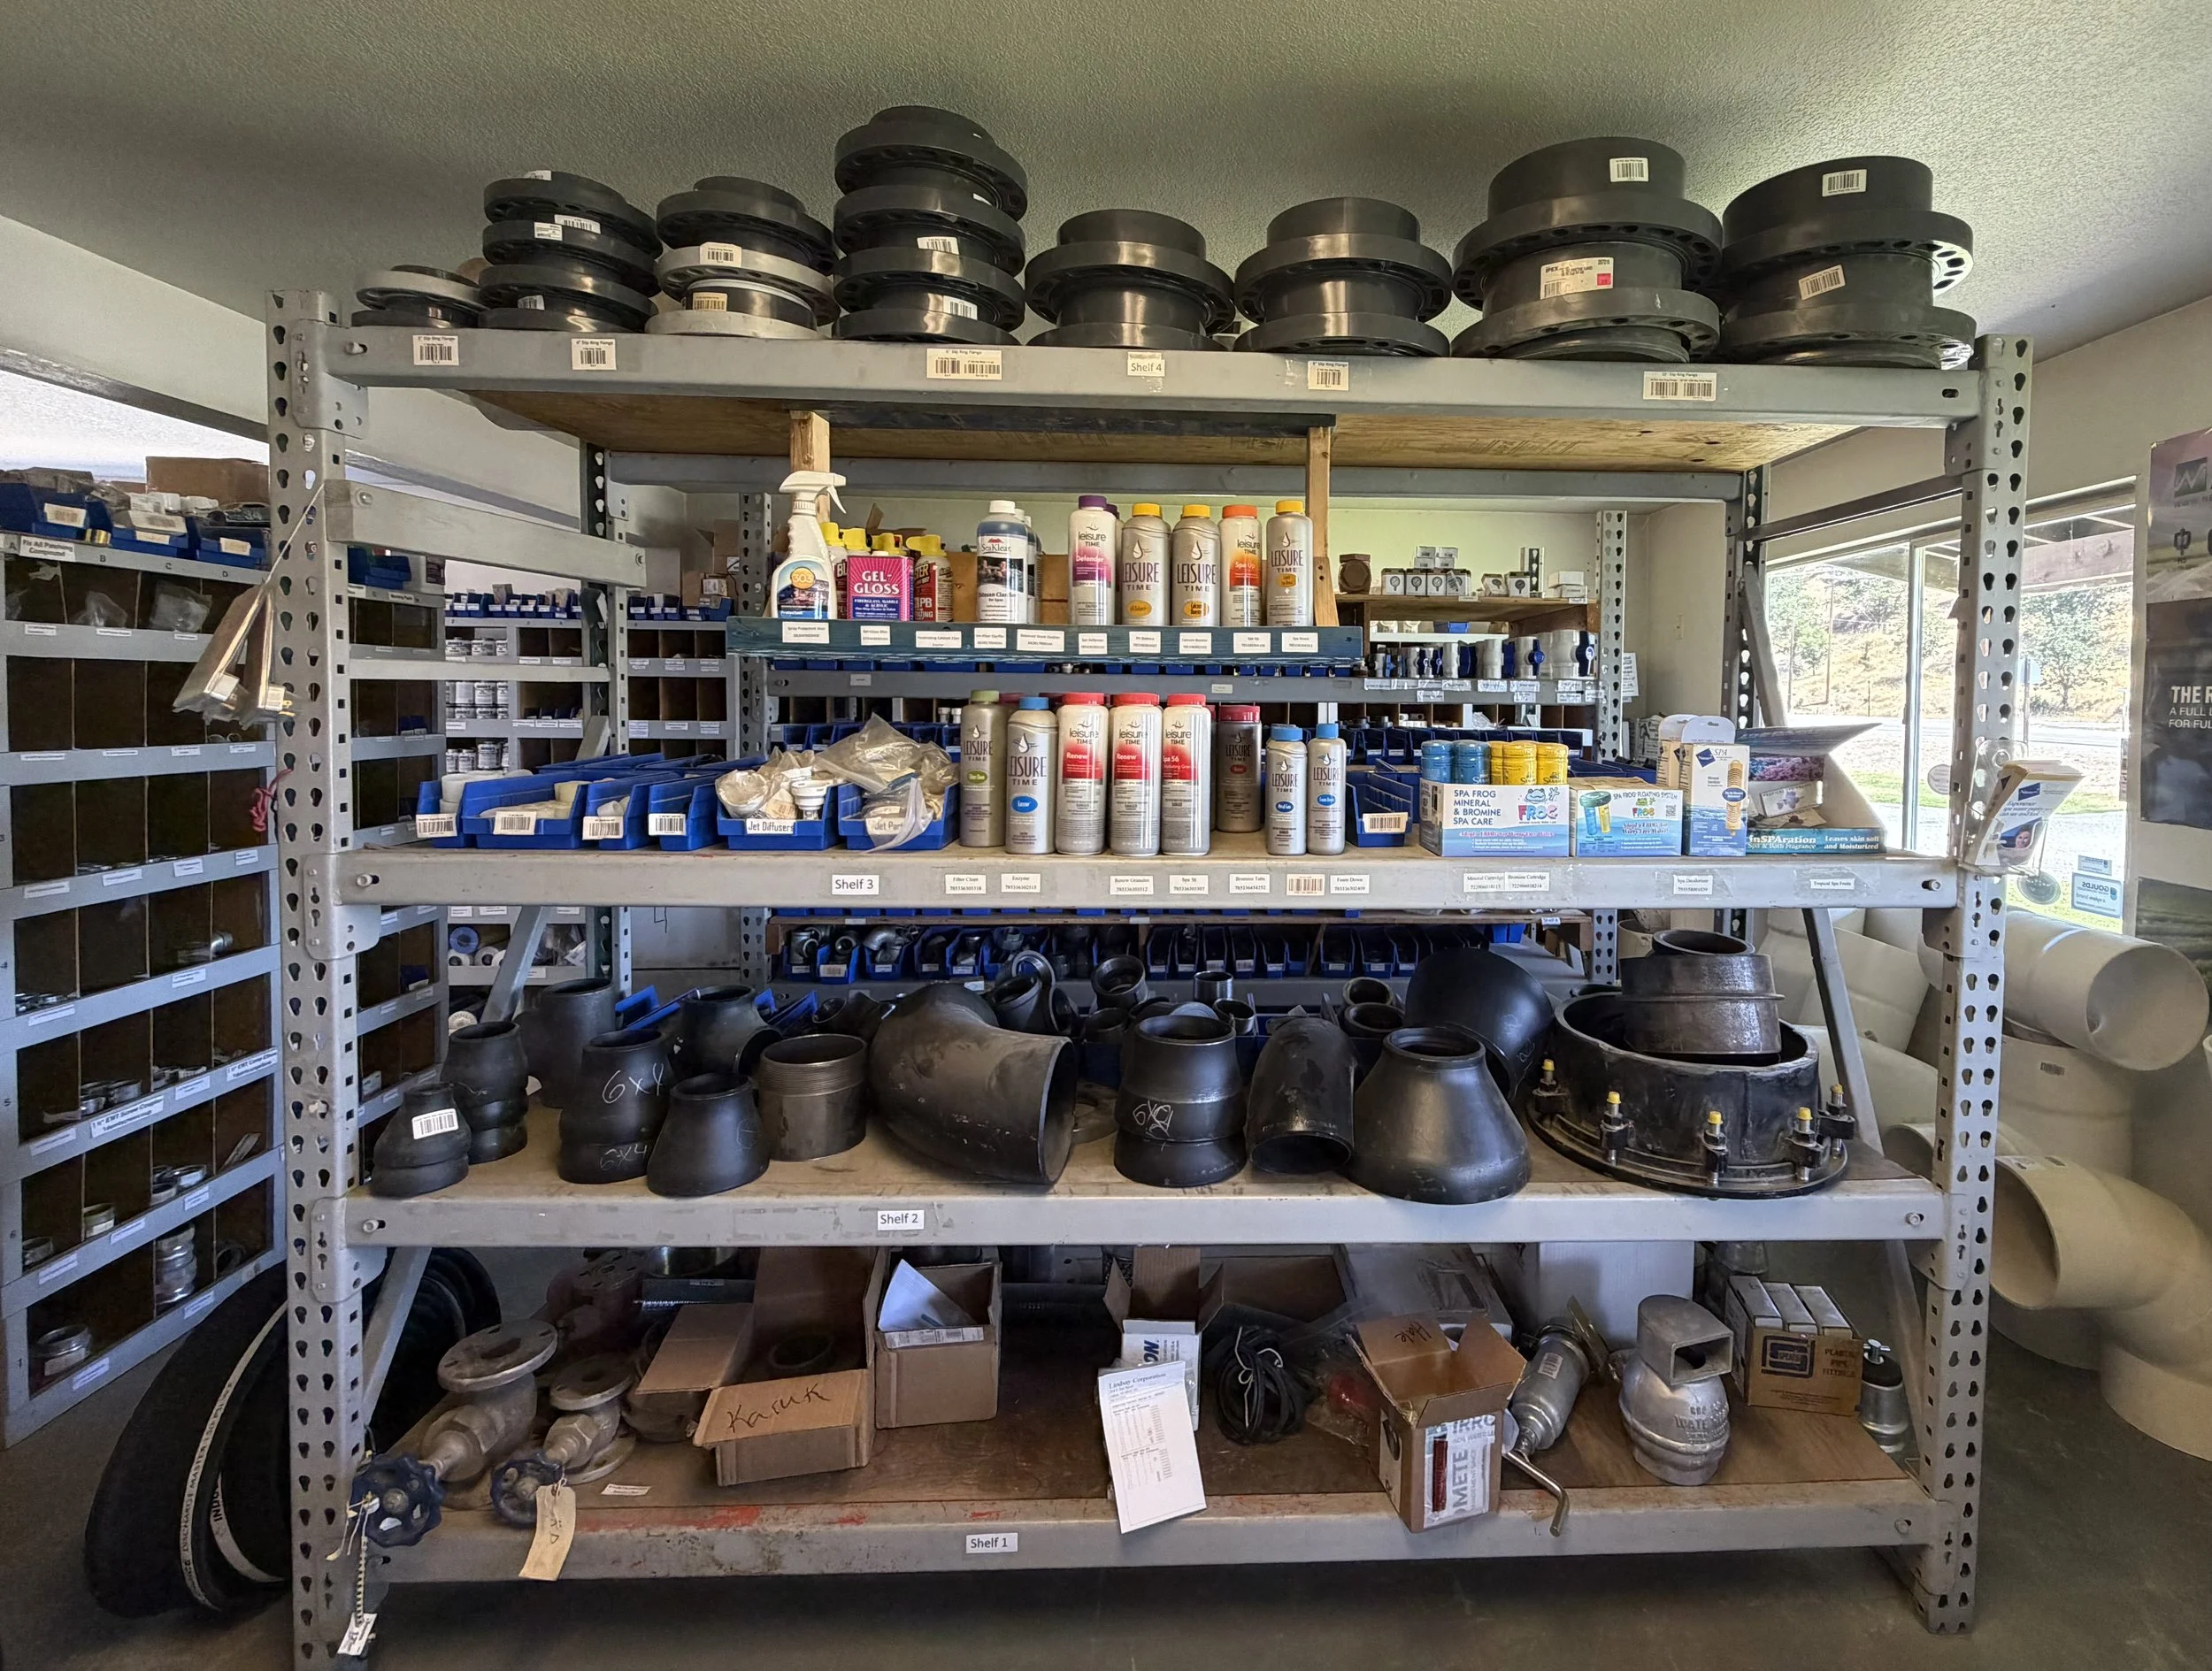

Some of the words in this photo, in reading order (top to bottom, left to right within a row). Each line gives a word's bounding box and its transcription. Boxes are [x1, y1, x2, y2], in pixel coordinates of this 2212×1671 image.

[1131, 363, 1154, 372] Shelf
[1078, 532, 1107, 541] leisure
[9, 542, 17, 551] A
[1237, 540, 1260, 549] leisure
[99, 554, 106, 563] B
[1271, 550, 1303, 567] LEISURE
[792, 573, 813, 582] 303
[862, 571, 893, 583] GEL-
[1123, 563, 1160, 583] LEISURE
[1177, 563, 1217, 585] LEISURE
[854, 583, 900, 594] GLOSS
[2171, 686, 2201, 703] THE
[2179, 708, 2207, 717] FULL
[2168, 719, 2191, 728] FOR
[2193, 720, 2212, 729] FUL
[1069, 729, 1099, 739] leisure
[1119, 729, 1148, 739] leisure
[1165, 729, 1192, 740] leisure
[964, 740, 994, 756] LEISURE
[1226, 744, 1252, 756] LEISURE
[1009, 756, 1047, 778] LEISURE
[1272, 773, 1298, 787] LEISURE
[1313, 768, 1341, 781] LEISURE
[1454, 789, 1470, 798] SPA
[1518, 805, 1558, 821] FROG
[1632, 808, 1655, 817] FROG
[748, 821, 760, 832] Jet
[762, 821, 795, 832] Diffusers
[874, 821, 885, 832] Jet
[1748, 835, 1816, 844] inSPAration
[835, 879, 864, 890] Shelf
[867, 879, 873, 890] 3
[4, 1098, 12, 1107] 5
[106, 1114, 119, 1123] EMT
[880, 1214, 910, 1224] Shelf
[911, 1214, 918, 1223] 2
[1831, 1359, 1848, 1368] PIPE
[1109, 1380, 1131, 1390] Lindsay
[1133, 1373, 1167, 1384] Corporation
[188, 1446, 207, 1489] MASTER
[971, 1537, 999, 1549] Shelf
[1002, 1537, 1008, 1548] 1
